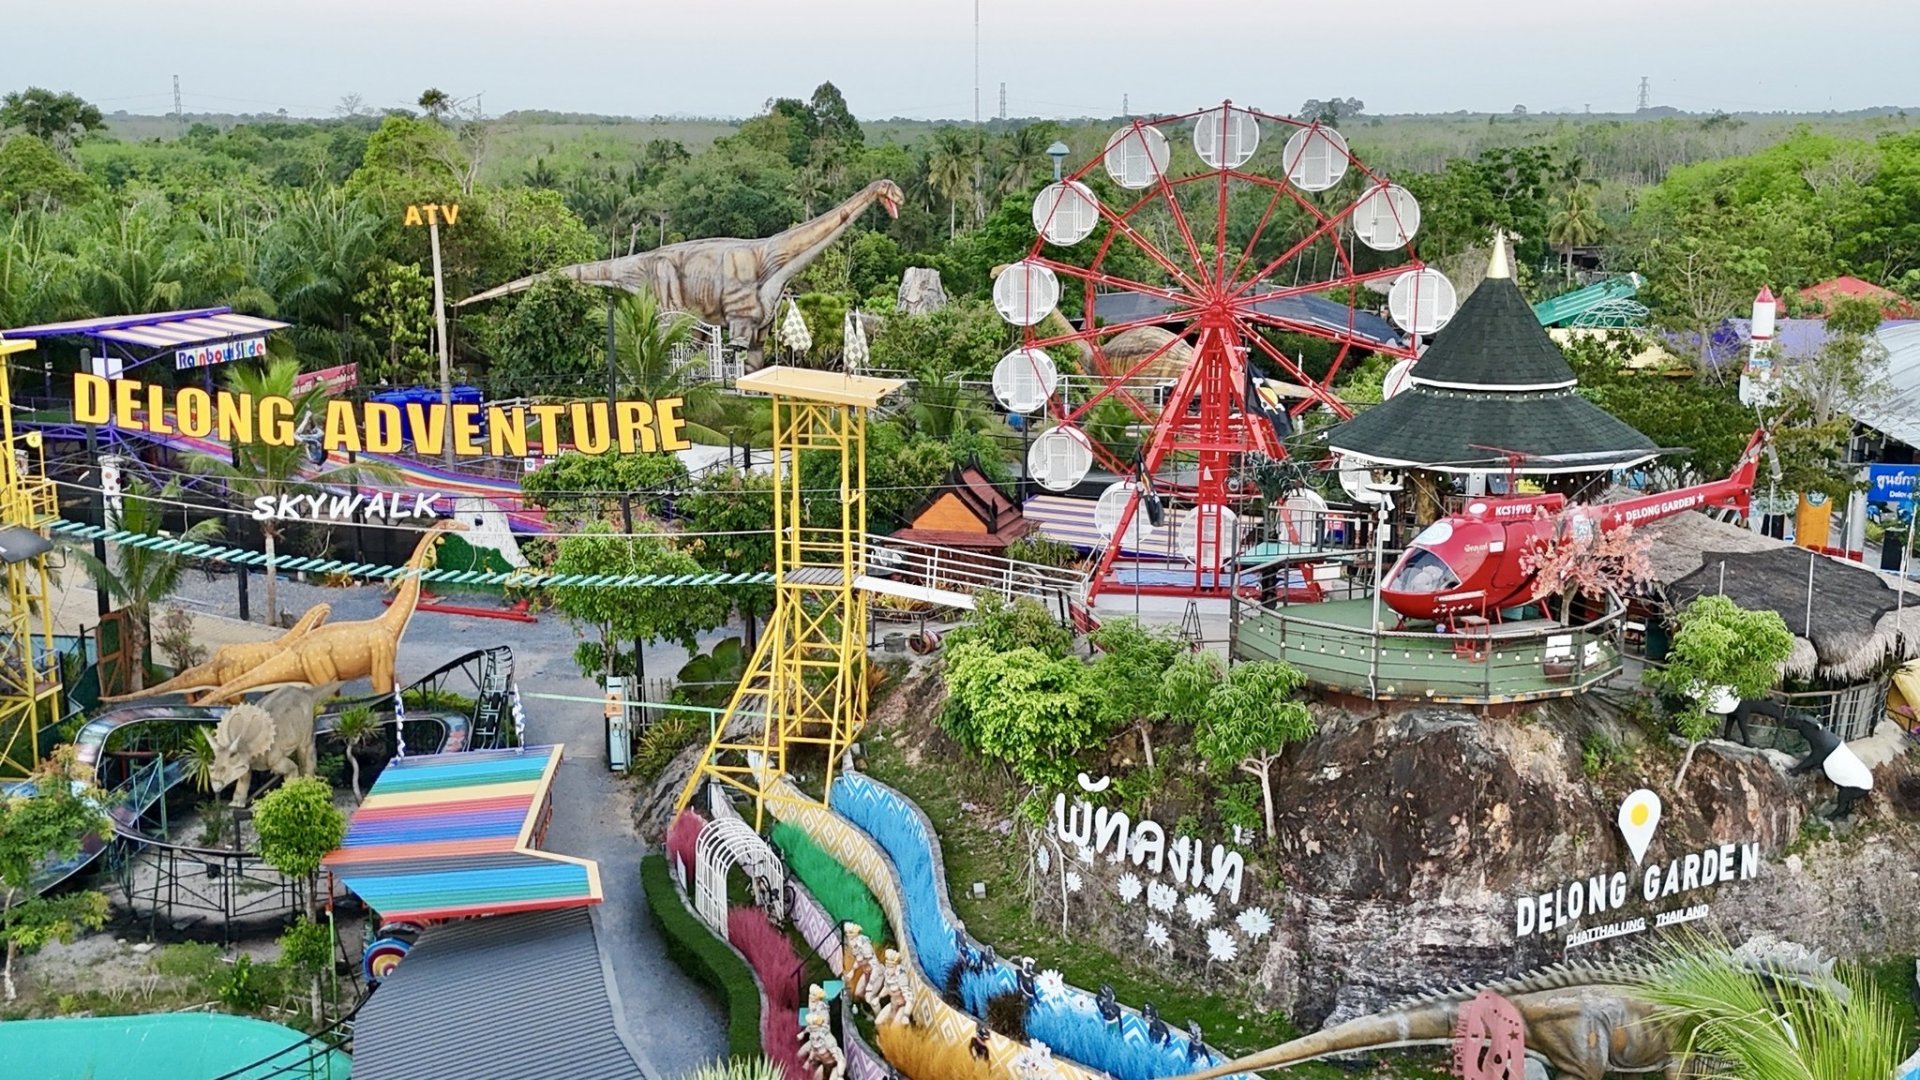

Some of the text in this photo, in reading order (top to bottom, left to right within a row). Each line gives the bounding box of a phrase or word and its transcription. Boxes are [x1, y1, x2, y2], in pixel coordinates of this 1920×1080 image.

[404, 203, 459, 226] ATV
[178, 341, 265, 368] Rainbow Slide
[73, 372, 692, 457] DELONG ADVENTURE
[252, 492, 441, 520] SKYWALK
[1626, 495, 1696, 521] DELONG GARDEN
[1517, 842, 1759, 937] DELONG GARDEN
[1566, 904, 1709, 948] PHATTHALUNG THAILAND
